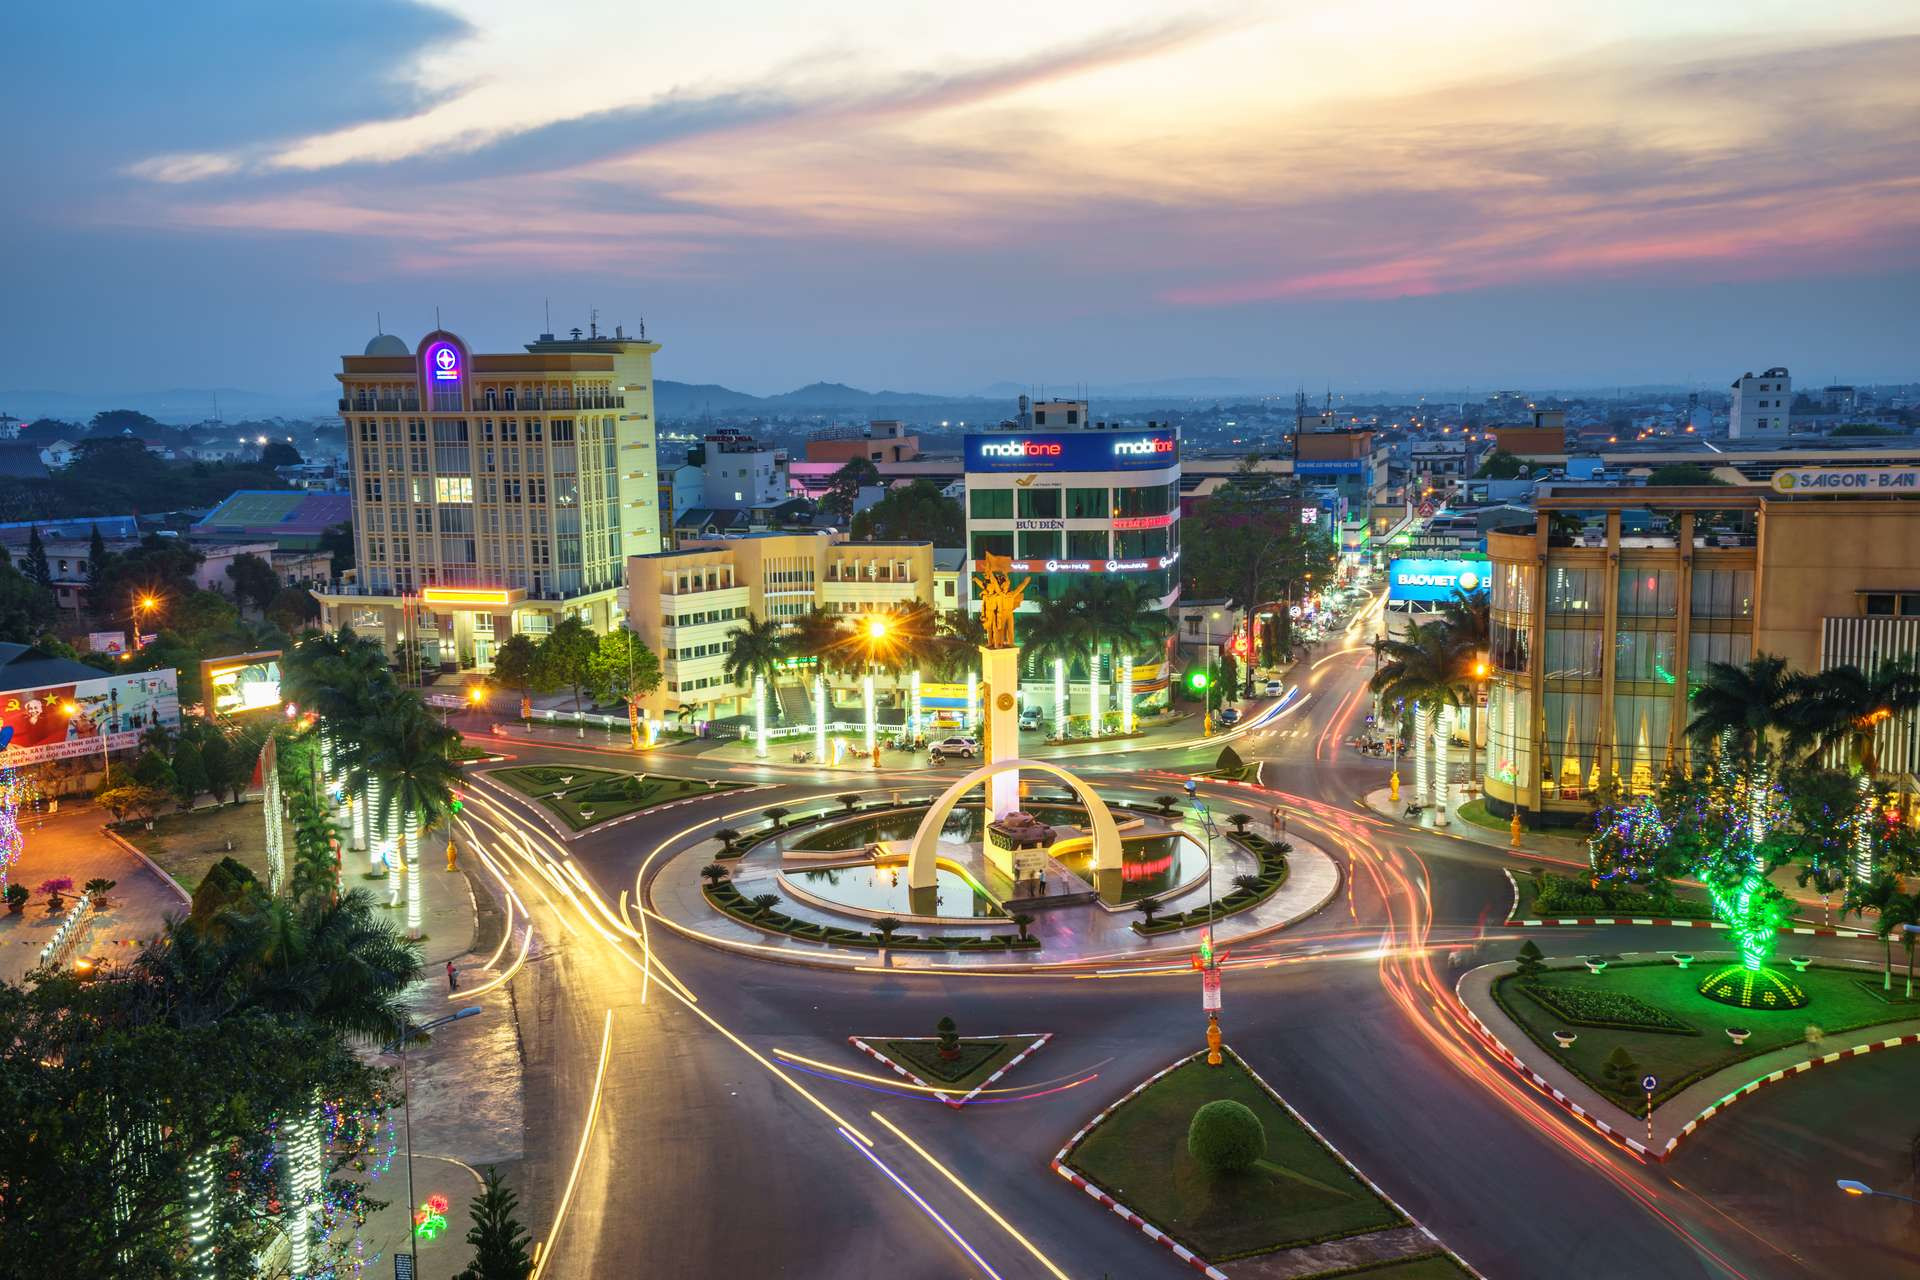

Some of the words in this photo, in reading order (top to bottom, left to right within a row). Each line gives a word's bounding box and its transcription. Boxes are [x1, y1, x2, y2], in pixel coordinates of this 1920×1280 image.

[982, 441, 1061, 456] mobifone
[1114, 438, 1173, 454] mobifone
[1800, 473, 1867, 487] SAIGON
[1398, 574, 1457, 587] BAOVIET
